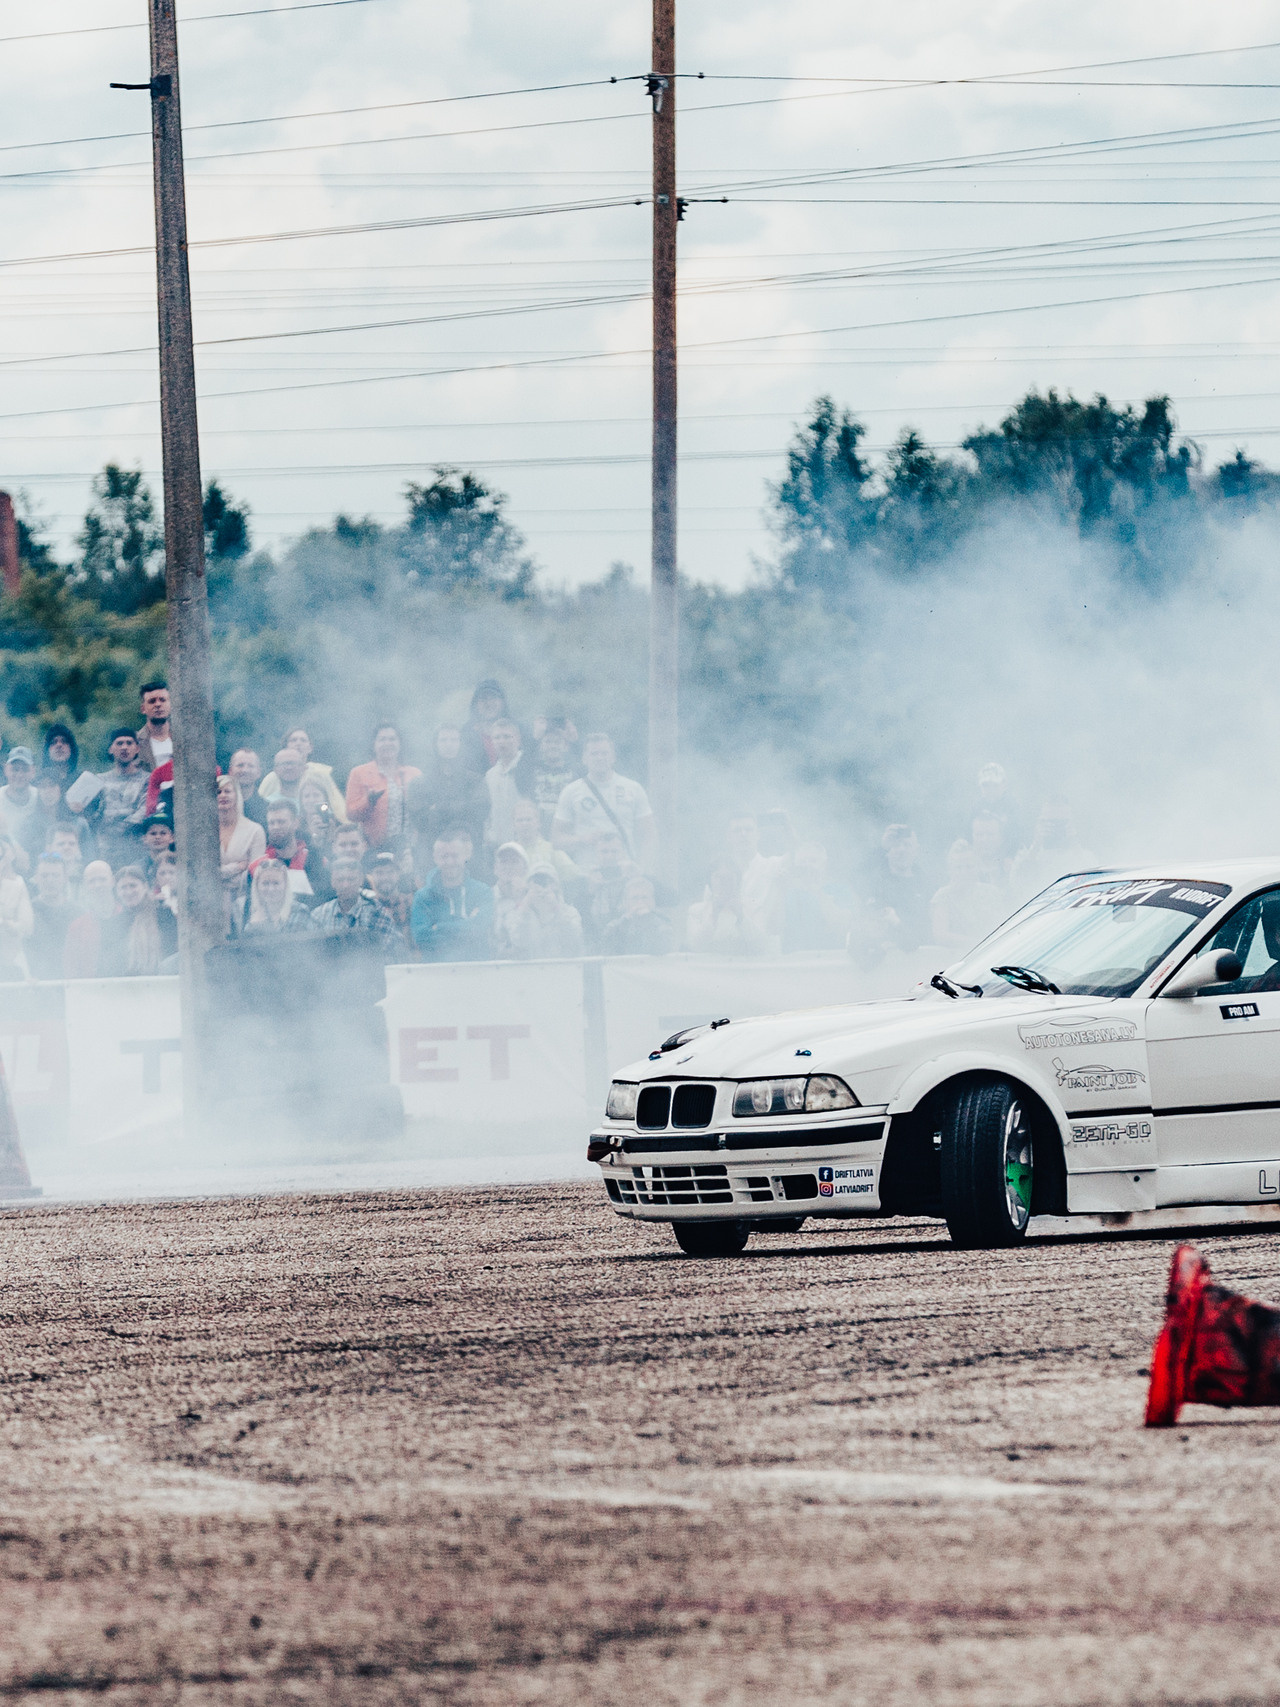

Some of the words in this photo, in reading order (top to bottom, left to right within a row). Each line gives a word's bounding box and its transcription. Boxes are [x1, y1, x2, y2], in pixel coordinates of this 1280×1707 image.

[1228, 1006, 1244, 1017] PRO
[1243, 1005, 1256, 1015] AM
[1025, 1026, 1136, 1050] AUTOTONESANA.LV
[1067, 1074, 1107, 1089] PAINT
[1109, 1073, 1137, 1088] JOB
[835, 1168, 874, 1179] DRIFTLATVIA
[835, 1183, 874, 1194] LATVIADRIFT
